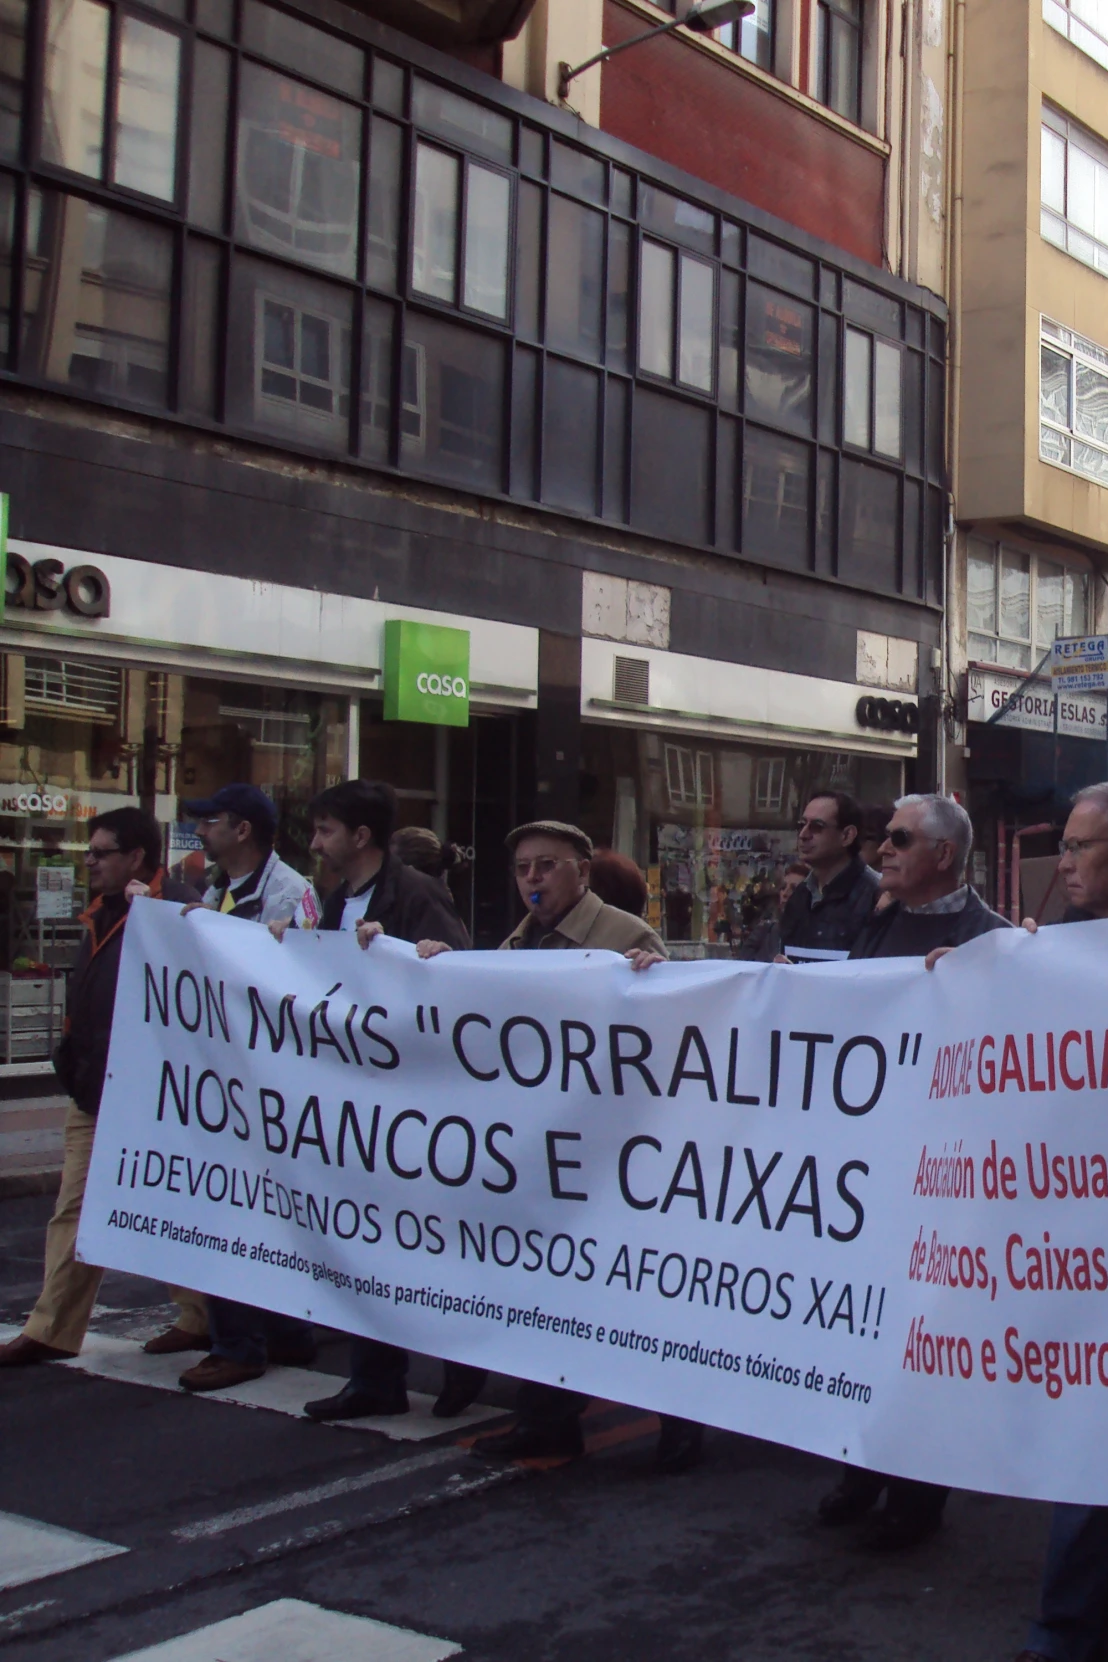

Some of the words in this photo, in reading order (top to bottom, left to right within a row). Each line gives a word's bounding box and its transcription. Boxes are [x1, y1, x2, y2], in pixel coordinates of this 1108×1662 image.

[5, 552, 110, 618] asa
[1055, 640, 1104, 655] RETEGA
[417, 670, 467, 698] casa
[1057, 681, 1105, 689] www.retega.es
[1061, 703, 1095, 724] ESLAS
[17, 794, 67, 812] casa
[170, 839, 204, 850] BRUGES
[144, 962, 230, 1044] NON
[247, 982, 400, 1070] MÁIS
[416, 1004, 922, 1116] "CORRALITO"
[928, 1038, 975, 1100] ADICAE
[157, 1060, 250, 1142] NOS
[260, 1087, 517, 1194] BANCOS
[546, 1130, 588, 1201] E
[617, 1133, 870, 1243] CAIXAS
[913, 1139, 974, 1200] Asociación
[982, 1139, 1016, 1199] de
[395, 1209, 446, 1254] OS
[459, 1220, 597, 1282] NOSOS
[606, 1243, 795, 1321] AFORROS
[803, 1276, 886, 1340] XA!!
[909, 1225, 925, 1278] de
[927, 1232, 997, 1301] Bancos,
[1005, 1231, 1108, 1291] Caixas
[108, 1208, 157, 1237] ADICAE
[160, 1219, 228, 1257] Plataforma
[230, 1236, 247, 1258] de
[249, 1242, 310, 1274] afectados
[312, 1262, 352, 1290] galegos
[354, 1276, 391, 1301] polas
[394, 1281, 503, 1324] participacións
[506, 1303, 592, 1341] preferentes
[596, 1325, 606, 1343] e
[609, 1328, 659, 1356] outros
[662, 1337, 742, 1374] productos
[745, 1352, 801, 1388] tóxicos
[804, 1367, 823, 1393] de
[826, 1371, 872, 1405] aforro
[903, 1316, 973, 1379] Aforro
[981, 1344, 997, 1383] e
